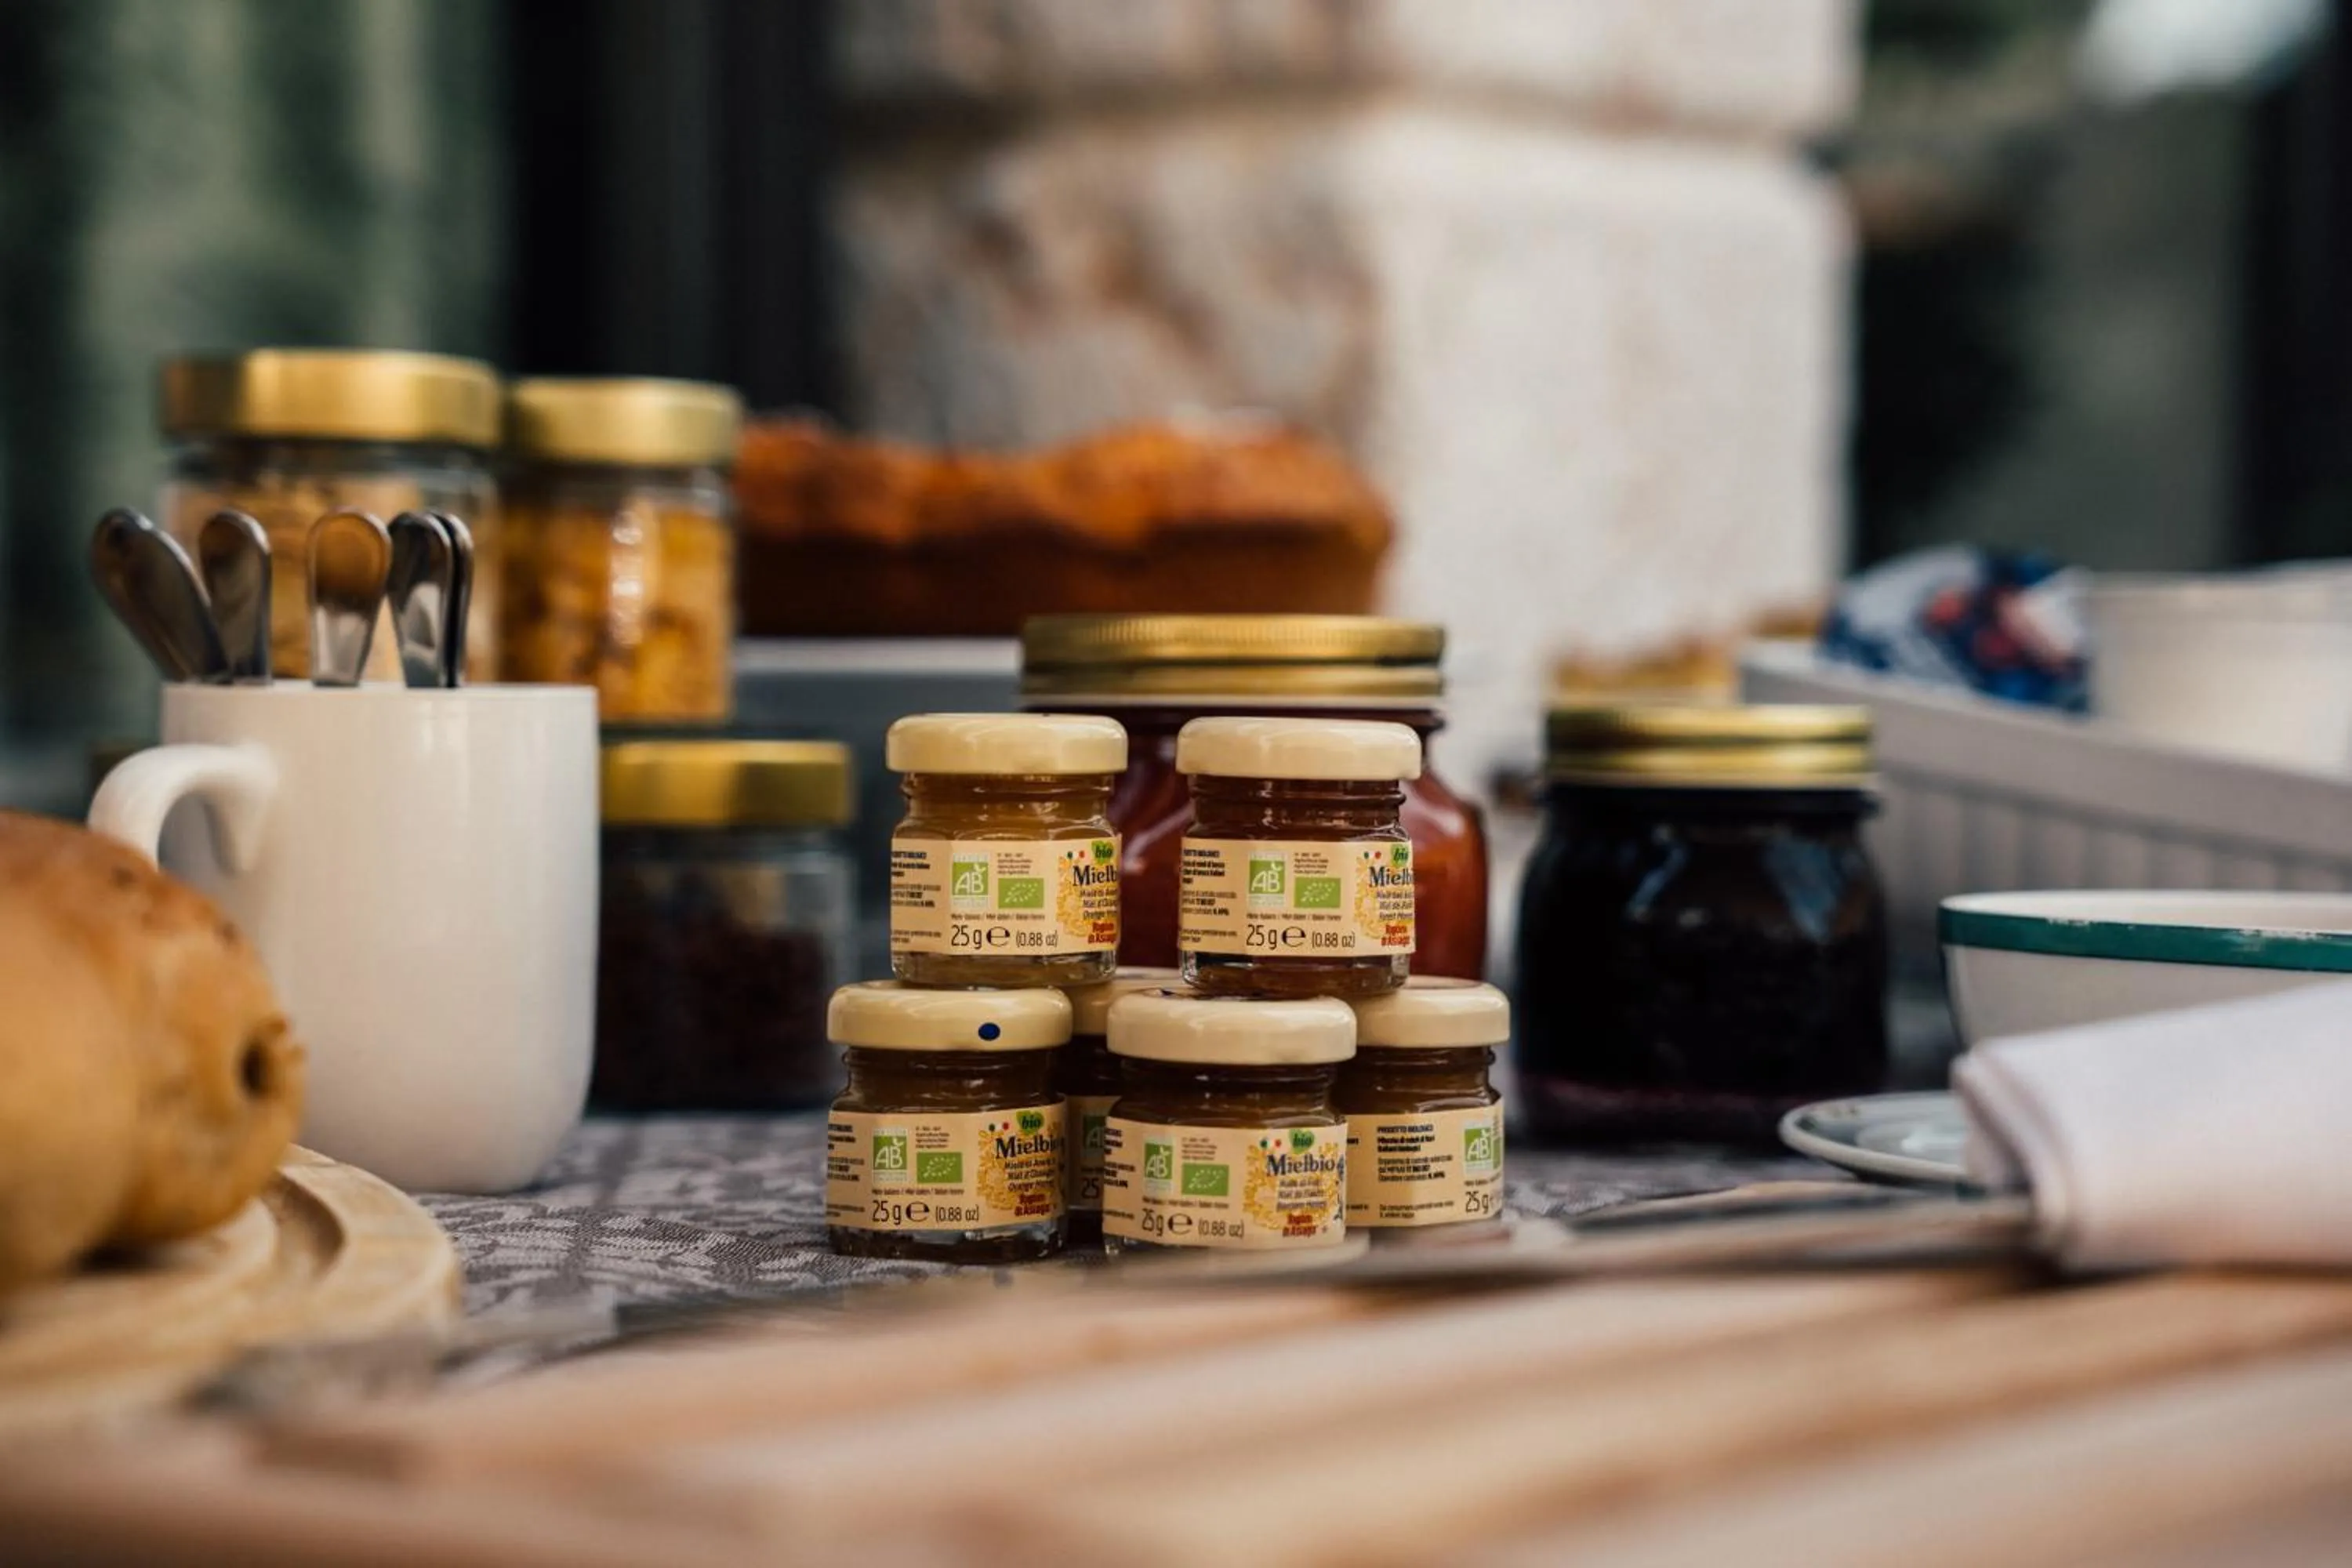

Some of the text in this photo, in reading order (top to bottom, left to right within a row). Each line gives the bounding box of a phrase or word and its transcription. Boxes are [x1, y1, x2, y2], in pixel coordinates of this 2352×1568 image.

[954, 871, 985, 894] AB
[1251, 870, 1280, 892] AB
[951, 924, 970, 946] 25
[973, 929, 982, 949] g
[1247, 924, 1265, 946] 25
[1269, 929, 1277, 950] g
[1022, 1114, 1041, 1130] bio
[874, 1145, 903, 1169] AB
[1467, 1138, 1490, 1160] AB
[1146, 1154, 1167, 1178] AB
[1266, 1154, 1335, 1177] Mielbio
[872, 1200, 890, 1221] 25
[893, 1204, 901, 1225] g
[1465, 1191, 1480, 1213] 25
[1482, 1194, 1489, 1214] g
[1142, 1208, 1156, 1232] 25
[1156, 1214, 1164, 1236] g
